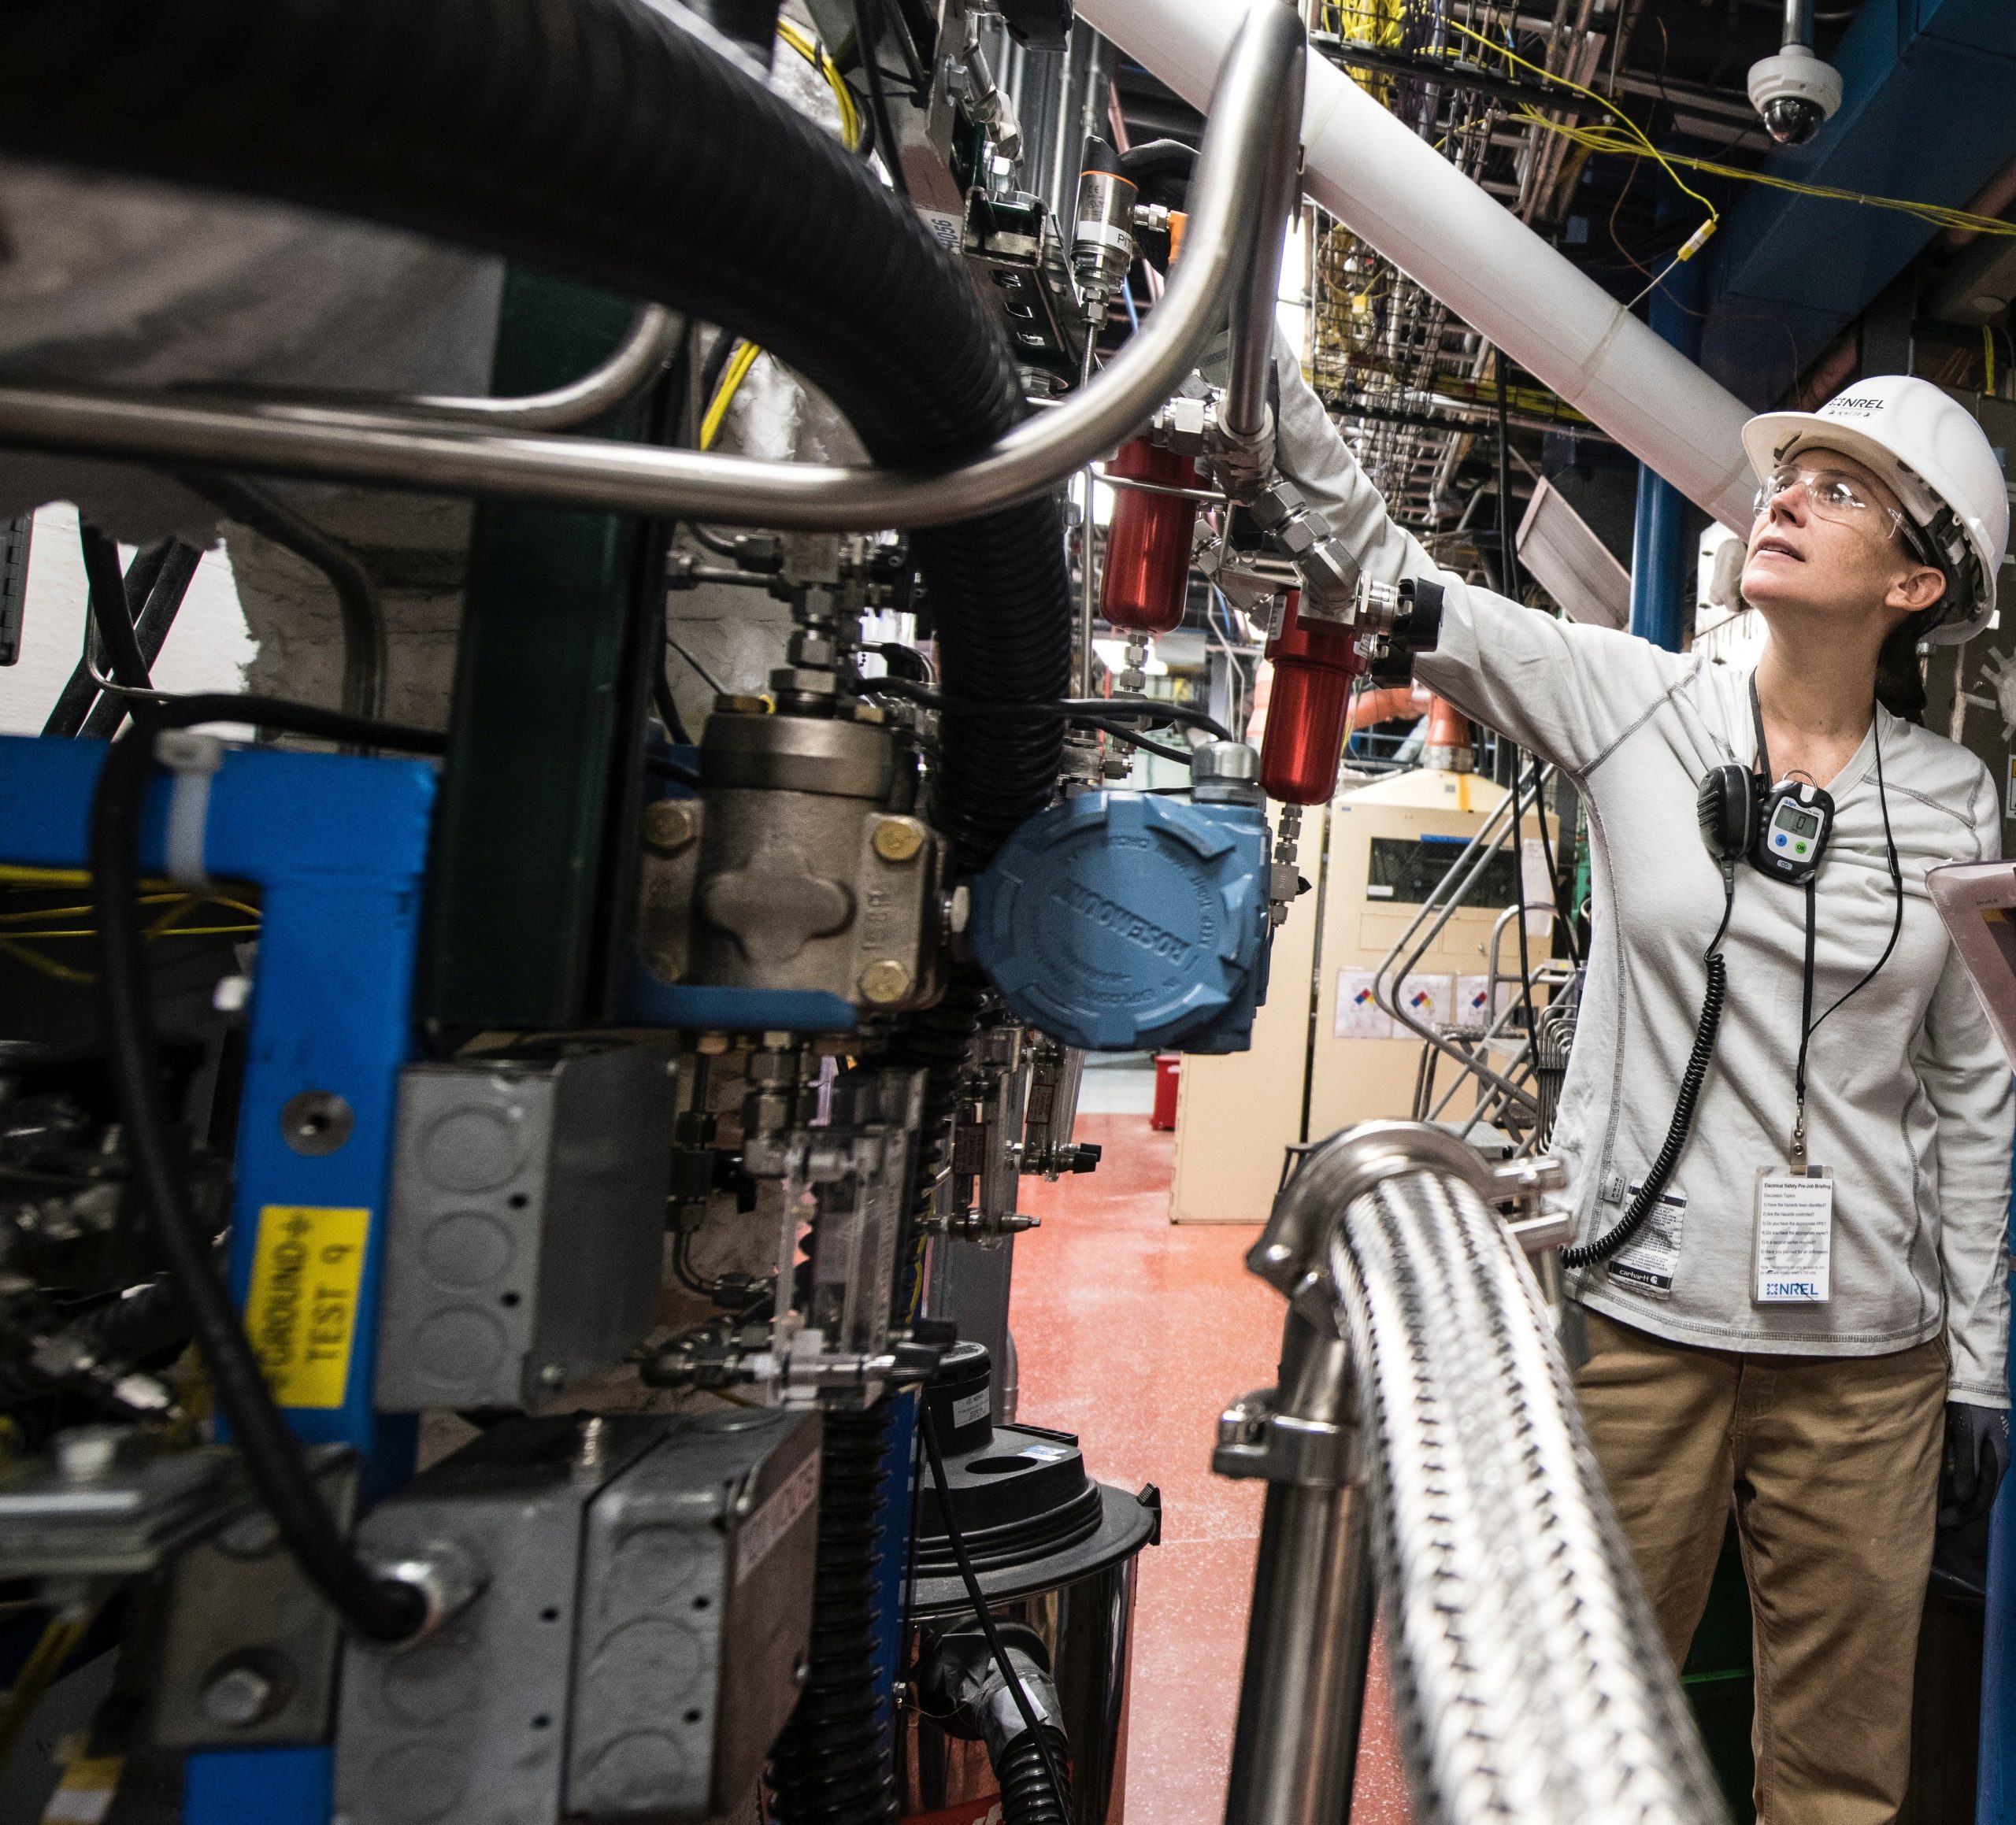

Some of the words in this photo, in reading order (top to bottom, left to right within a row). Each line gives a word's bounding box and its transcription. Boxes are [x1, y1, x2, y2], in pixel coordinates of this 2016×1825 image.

[1843, 398, 1884, 409] NREL
[1796, 816, 1807, 830] 0
[1618, 1268, 1649, 1282] carhartt
[1780, 1283, 1819, 1295] NREL
[261, 1240, 308, 1368] GROUND
[303, 1283, 351, 1366] TEST
